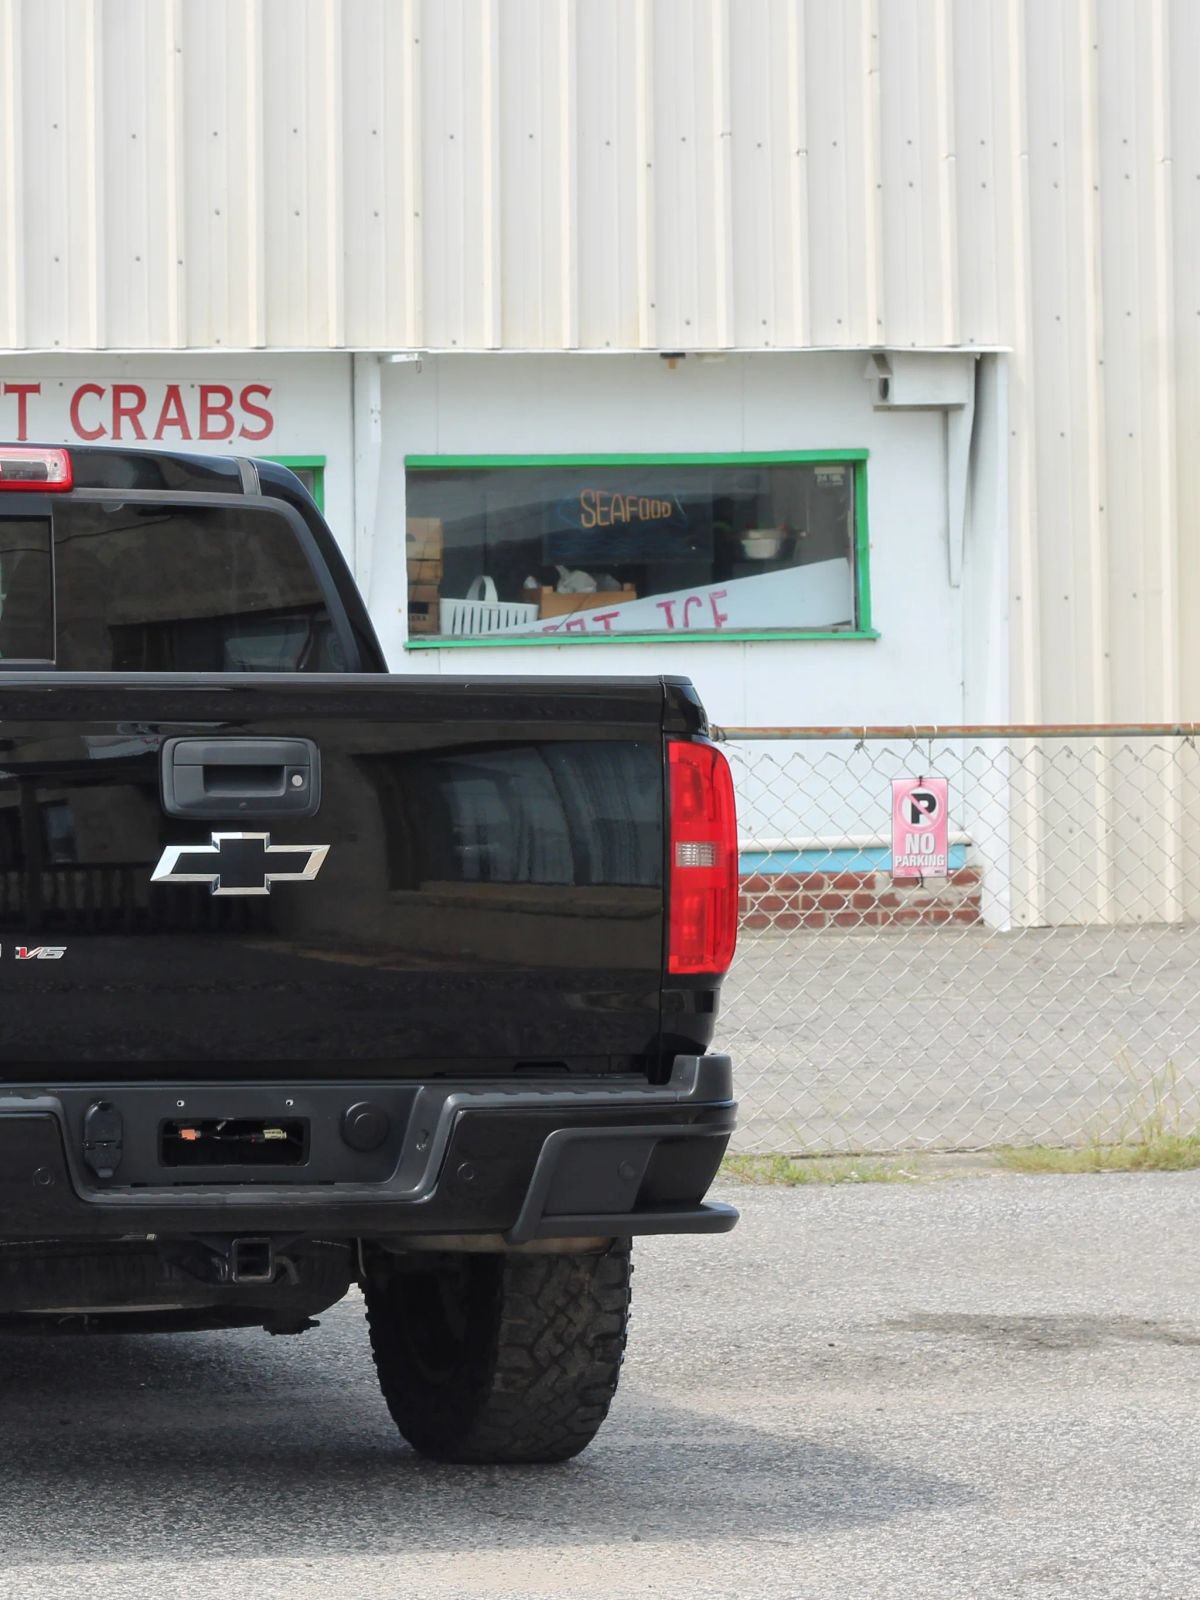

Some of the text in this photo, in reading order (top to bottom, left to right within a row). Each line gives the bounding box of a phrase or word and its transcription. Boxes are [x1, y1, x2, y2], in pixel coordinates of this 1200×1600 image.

[69, 383, 275, 441] CRABS
[580, 488, 672, 528] SEAFOOD
[905, 832, 935, 855] NO
[895, 855, 945, 867] PARKING
[15, 946, 67, 960] V6
